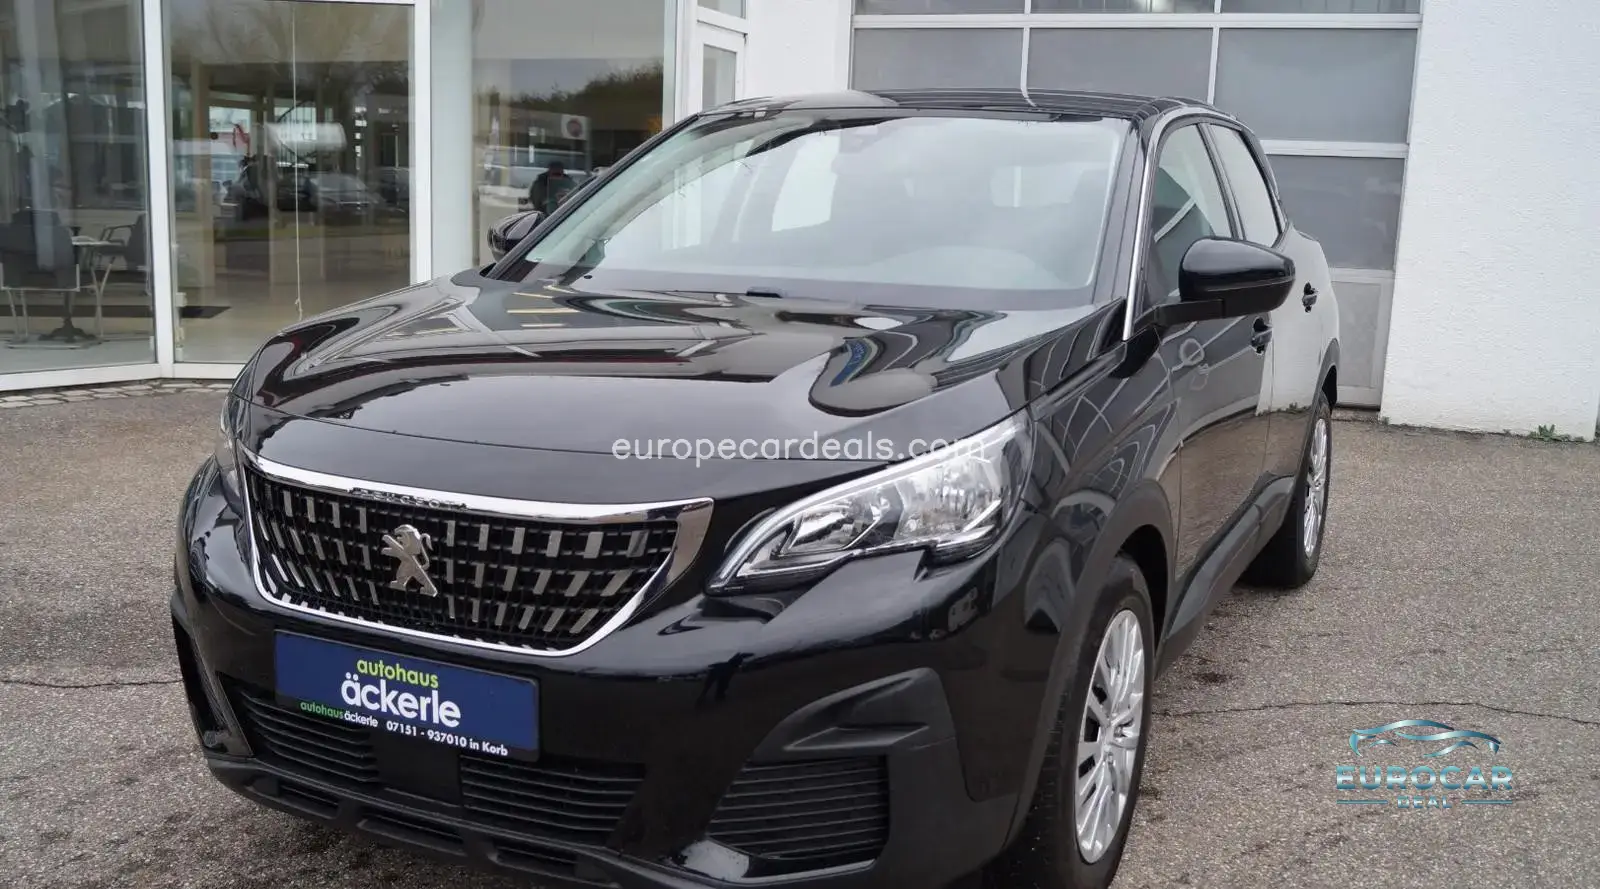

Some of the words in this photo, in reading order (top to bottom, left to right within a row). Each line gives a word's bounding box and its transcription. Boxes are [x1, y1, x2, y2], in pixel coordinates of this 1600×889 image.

[356, 659, 439, 689] autohaus
[341, 672, 461, 728] äckerle
[386, 720, 417, 737] 07151
[427, 729, 467, 748] 937010
[469, 738, 480, 751] in
[482, 741, 509, 756] Korb
